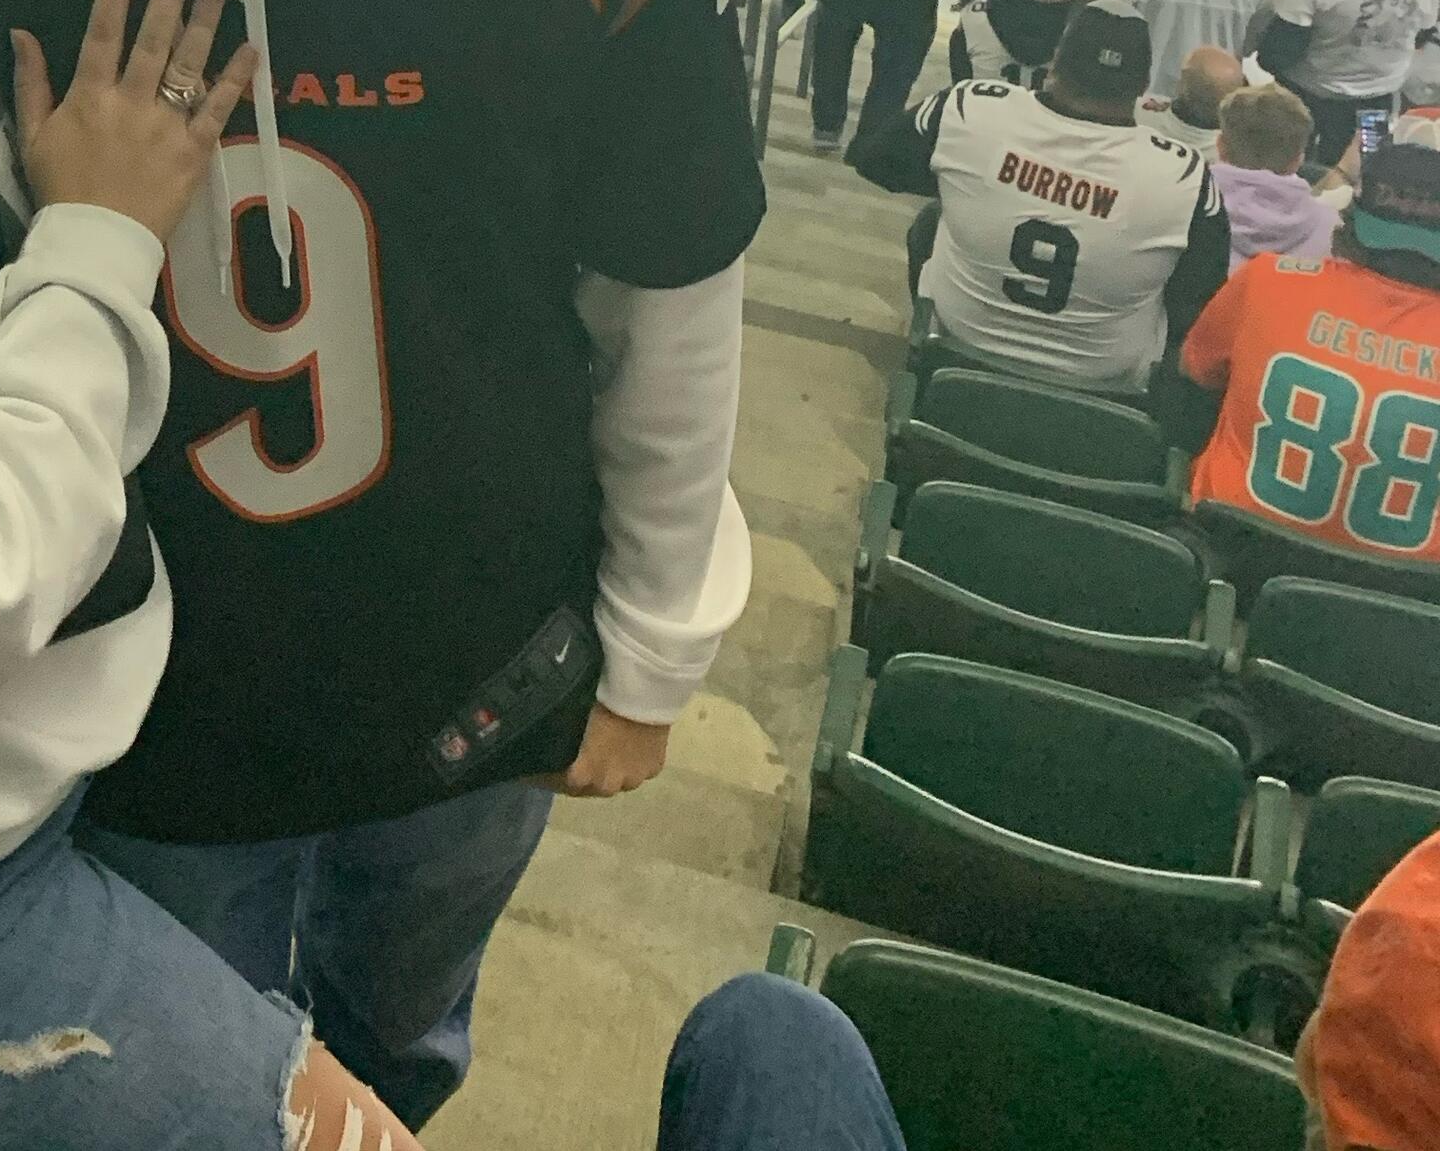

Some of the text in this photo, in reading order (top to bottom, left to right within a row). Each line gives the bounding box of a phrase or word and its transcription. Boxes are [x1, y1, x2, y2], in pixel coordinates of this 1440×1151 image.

[997, 151, 1119, 220] BURROW
[160, 133, 395, 525] 9
[1002, 219, 1080, 315] 9
[1246, 351, 1440, 552] 88
